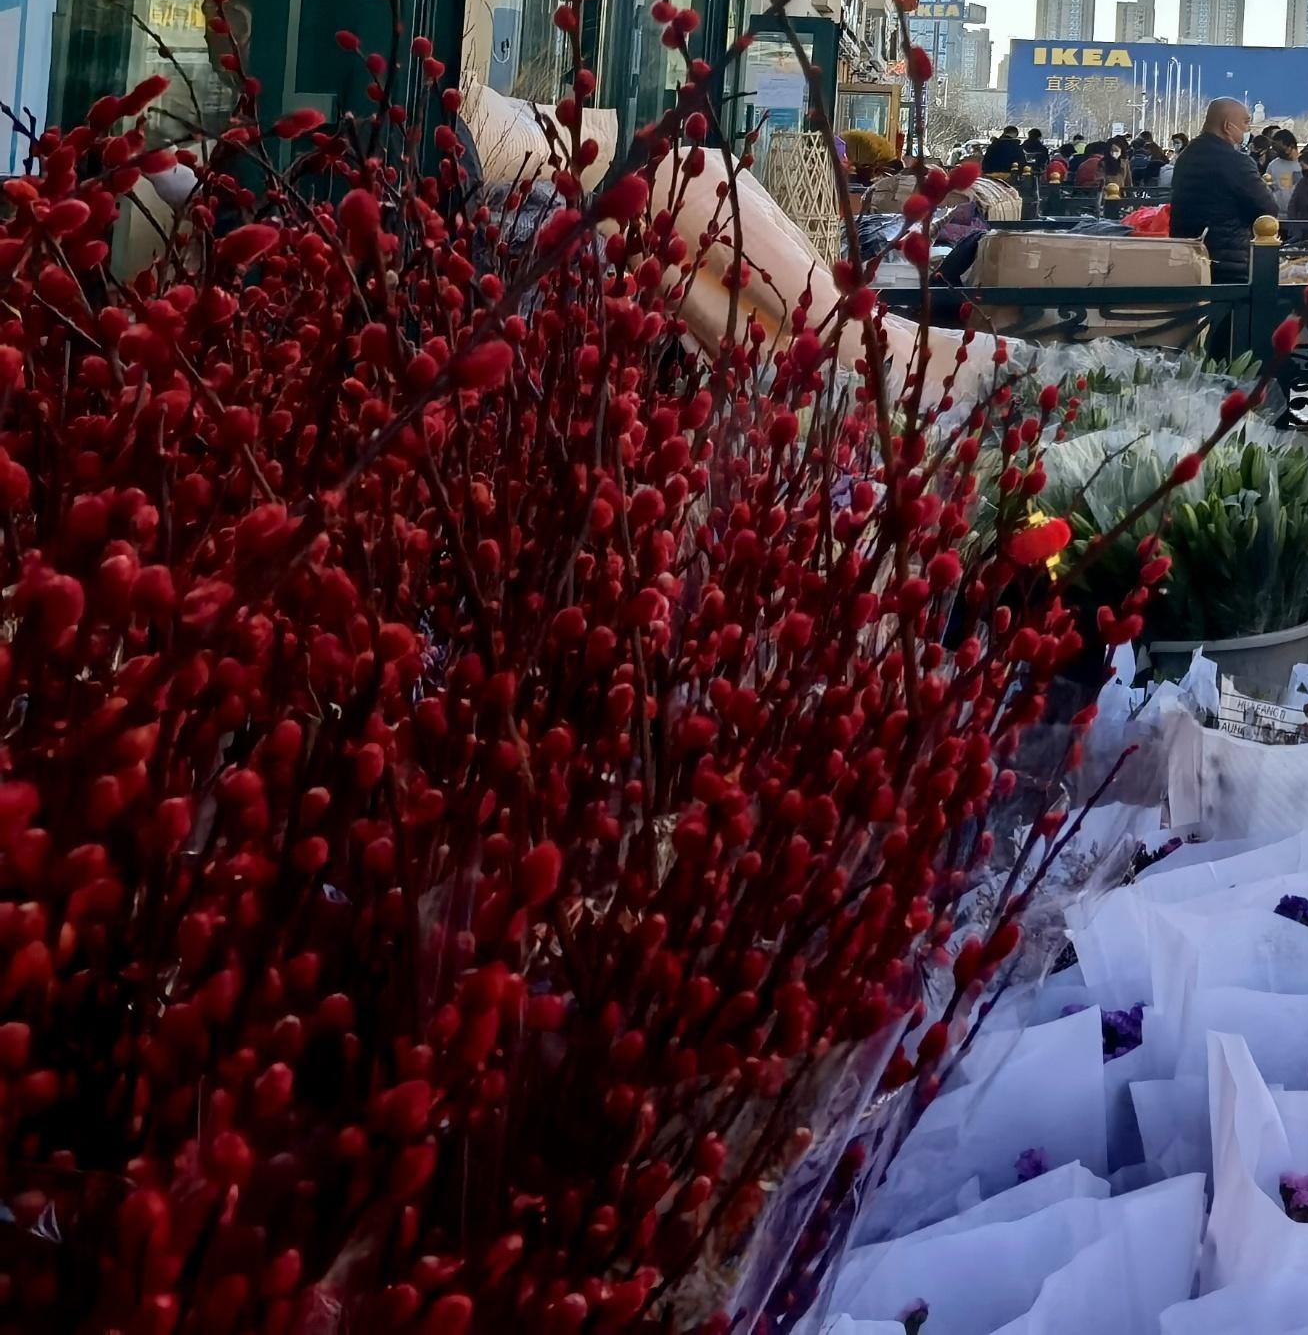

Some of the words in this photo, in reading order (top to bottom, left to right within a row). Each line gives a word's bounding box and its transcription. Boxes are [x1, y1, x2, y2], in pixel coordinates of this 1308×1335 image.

[1034, 47, 1134, 68] IKEA
[1045, 76, 1120, 92] 宜家家居
